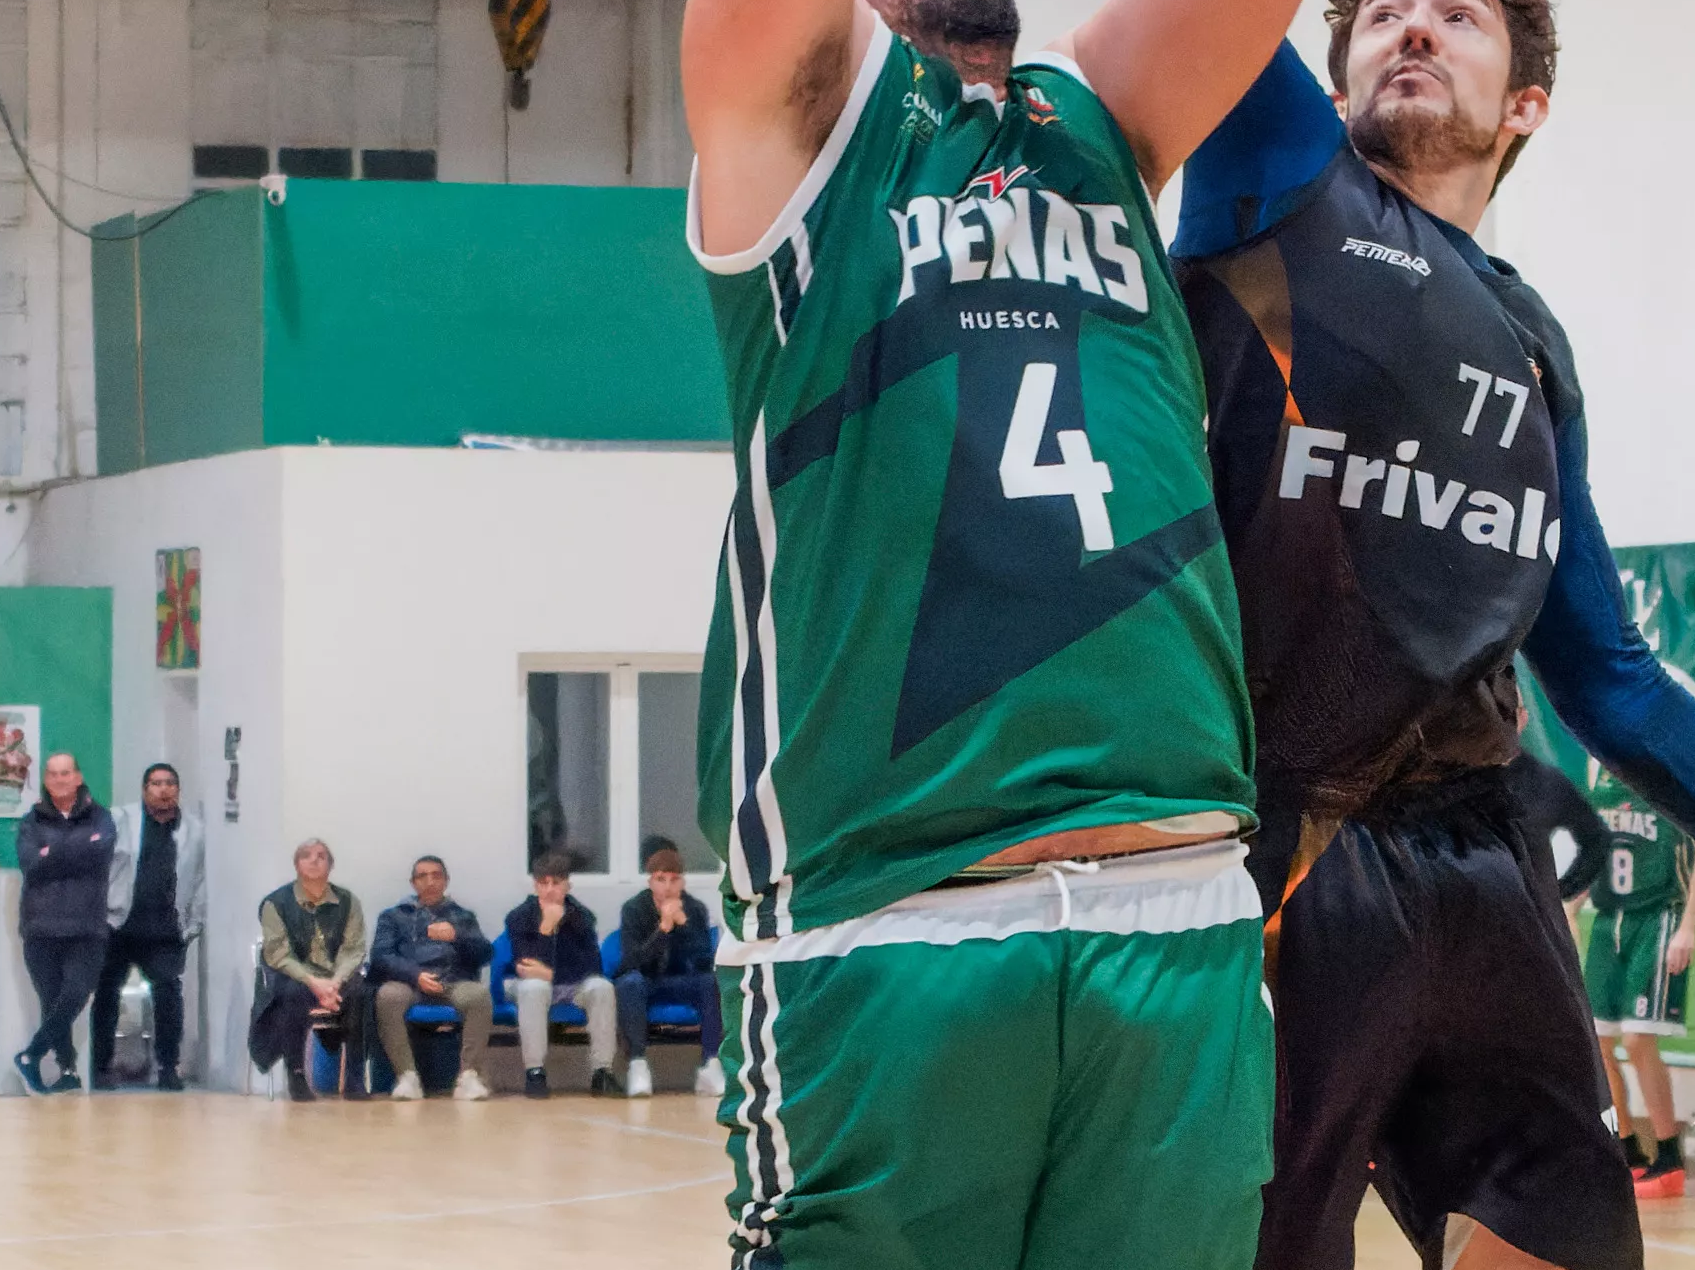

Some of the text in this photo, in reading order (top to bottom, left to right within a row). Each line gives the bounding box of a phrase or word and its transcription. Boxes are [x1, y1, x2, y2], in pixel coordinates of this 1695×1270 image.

[959, 309, 1061, 330] HUESCA
[1457, 362, 1530, 449] 77
[998, 362, 1114, 552] 4
[1612, 848, 1634, 895] 8
